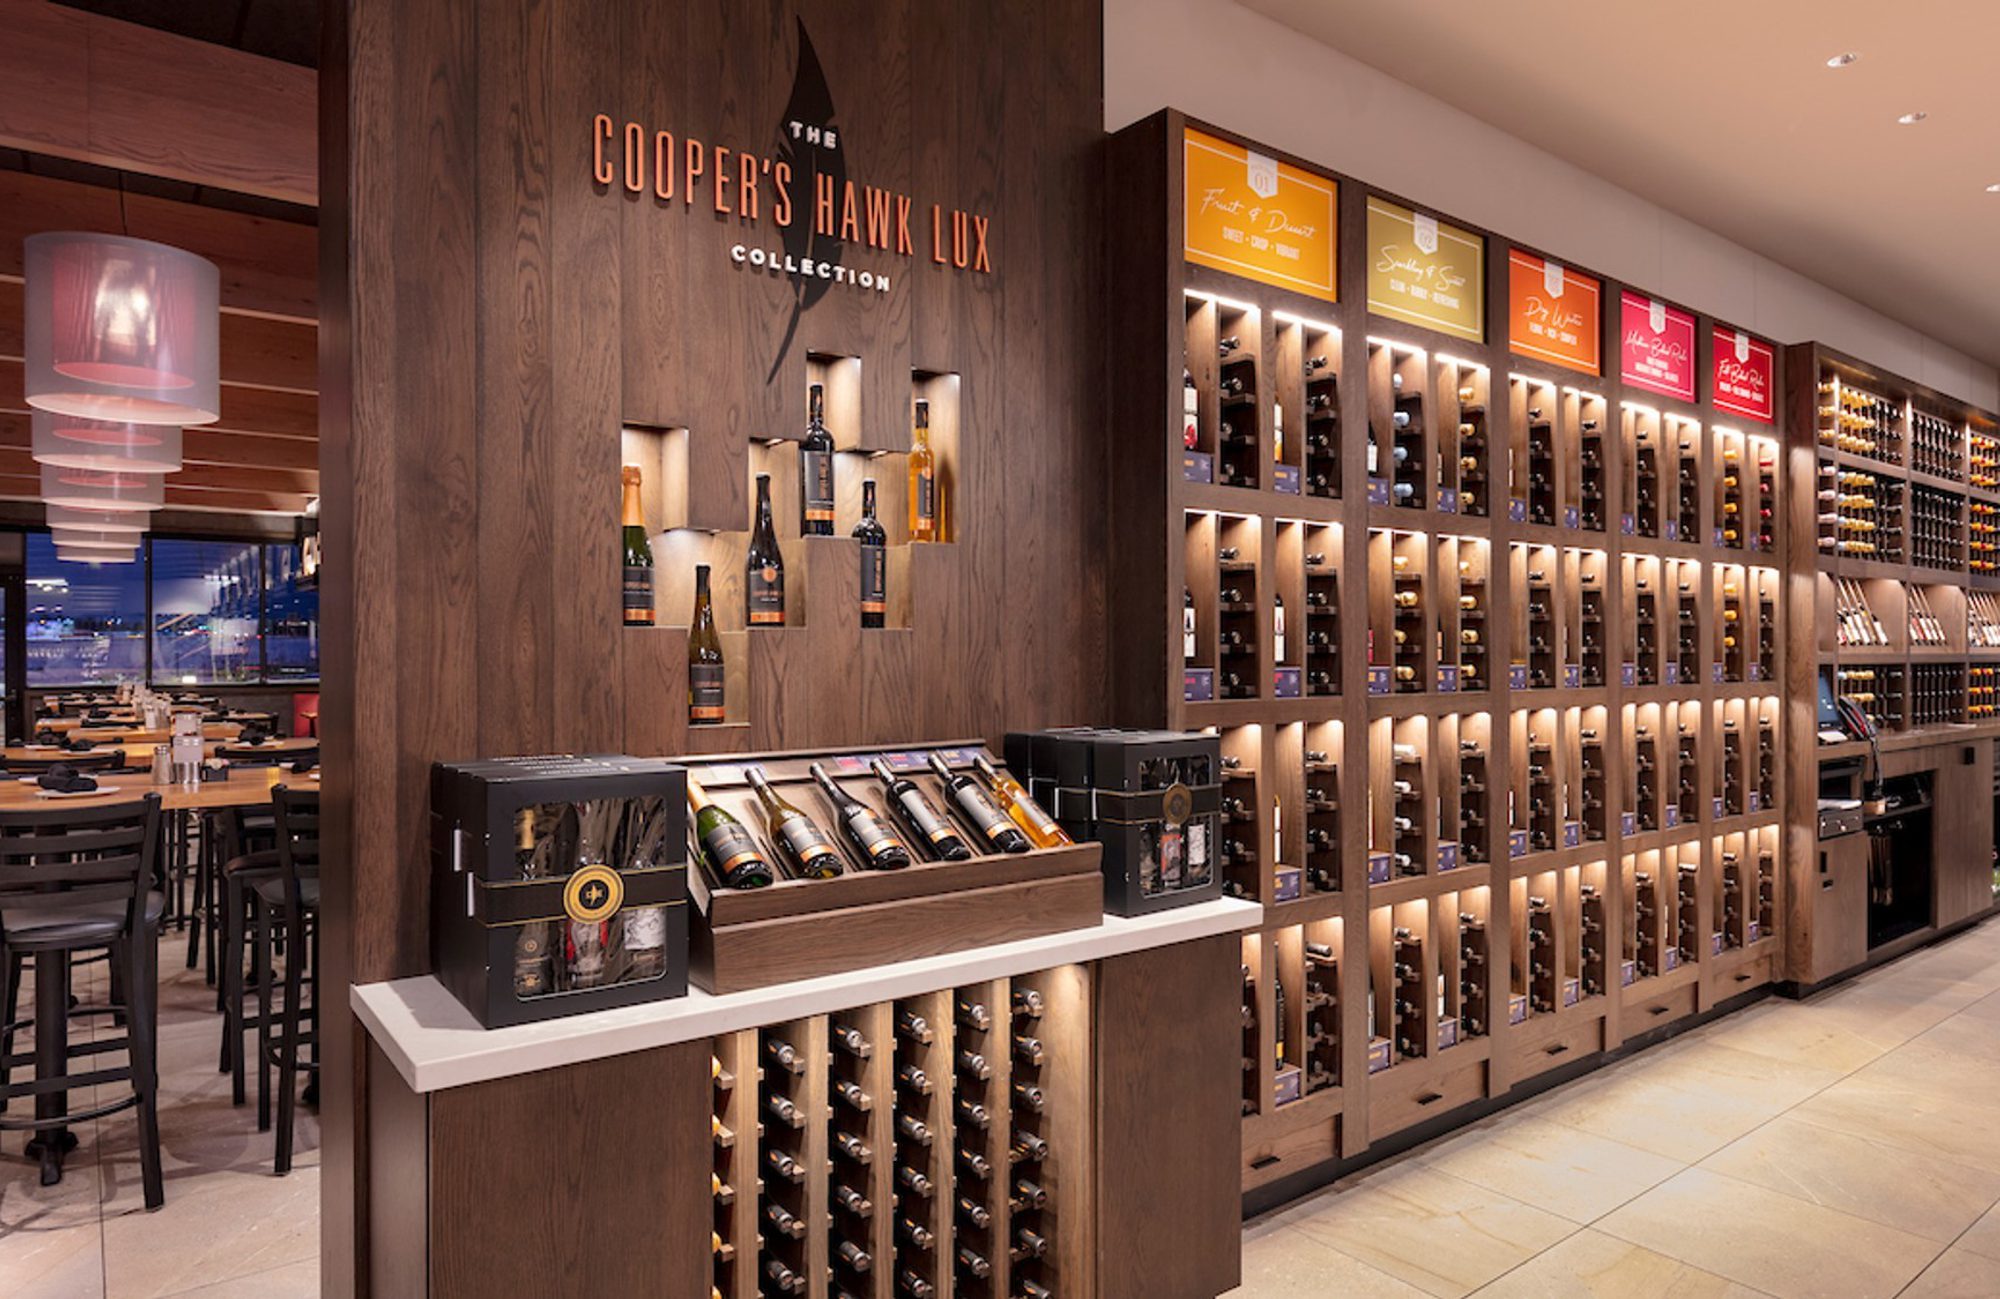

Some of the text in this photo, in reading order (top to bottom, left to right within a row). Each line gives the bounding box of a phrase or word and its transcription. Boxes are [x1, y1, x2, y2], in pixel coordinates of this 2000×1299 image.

[788, 121, 837, 149] THE
[593, 113, 991, 274] COOPER'S HAWK LUX
[730, 244, 890, 292] COLLECTION
